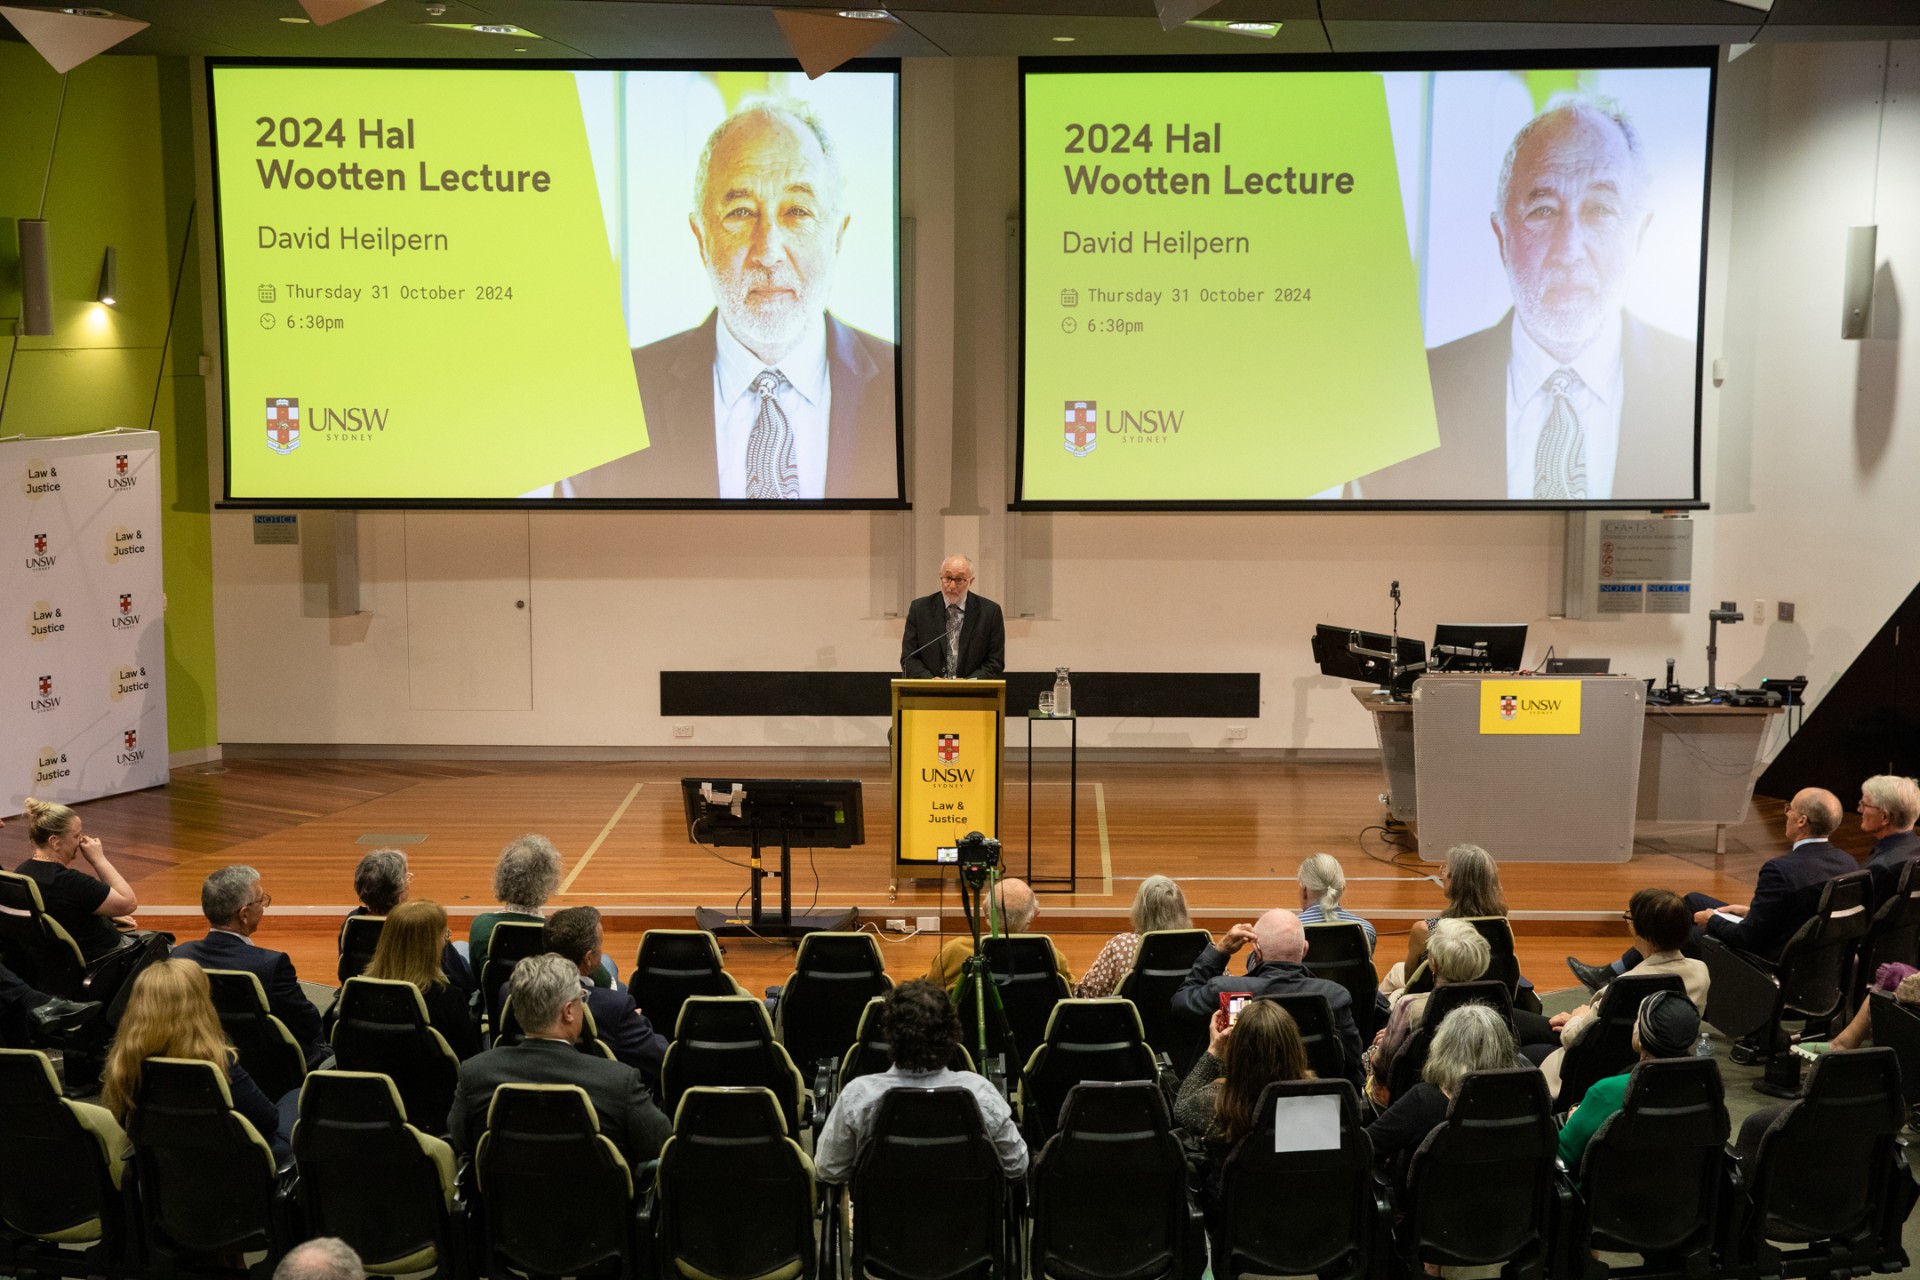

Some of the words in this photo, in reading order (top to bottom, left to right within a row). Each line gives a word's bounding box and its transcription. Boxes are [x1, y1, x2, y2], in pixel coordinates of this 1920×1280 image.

[256, 116, 346, 148] 2024
[358, 118, 415, 150] Hal
[1064, 123, 1153, 154] 2024
[1166, 122, 1221, 154] Hal
[256, 158, 406, 191] Wootten
[419, 161, 551, 193] Lecture
[1063, 164, 1210, 195] Wootten
[1224, 164, 1355, 195] Lecture
[258, 225, 330, 249] David
[340, 226, 448, 257] Heilpern
[1063, 230, 1133, 254] David
[1143, 230, 1249, 260] Heilpern
[286, 284, 362, 302] Thursday
[372, 285, 389, 299] 31
[400, 285, 466, 300] October
[476, 286, 513, 300] 2024
[1088, 288, 1162, 306] Thursday
[1172, 288, 1189, 302] 31
[1200, 288, 1265, 302] October
[1274, 288, 1312, 302] 2024
[286, 315, 344, 332] 6:30pm
[1087, 318, 1144, 336] 6:30pm
[308, 407, 389, 432] UNSW
[1105, 409, 1184, 434] UNSW
[28, 468, 48, 479] Law
[50, 467, 57, 477] &
[26, 482, 61, 494] Justice
[108, 476, 137, 489] UNSW
[255, 515, 296, 523] NOTICE
[115, 532, 134, 542] Law
[136, 530, 142, 540] &
[113, 545, 145, 556] Justice
[25, 556, 57, 569] UNSW
[33, 611, 53, 621] Law
[55, 608, 62, 617] &
[112, 615, 141, 628] UNSW
[31, 623, 65, 636] Justice
[119, 669, 138, 680] Law
[140, 667, 146, 676] &
[118, 682, 149, 694] Justice
[30, 697, 62, 711] UNSW
[1521, 699, 1562, 711] UNSW
[39, 757, 58, 767] Law
[60, 754, 67, 763] &
[117, 750, 145, 764] UNSW
[36, 768, 70, 782] Justice
[922, 768, 974, 782] UNSW
[932, 801, 954, 810] Law
[957, 801, 965, 810] &
[928, 814, 968, 824] Justice
